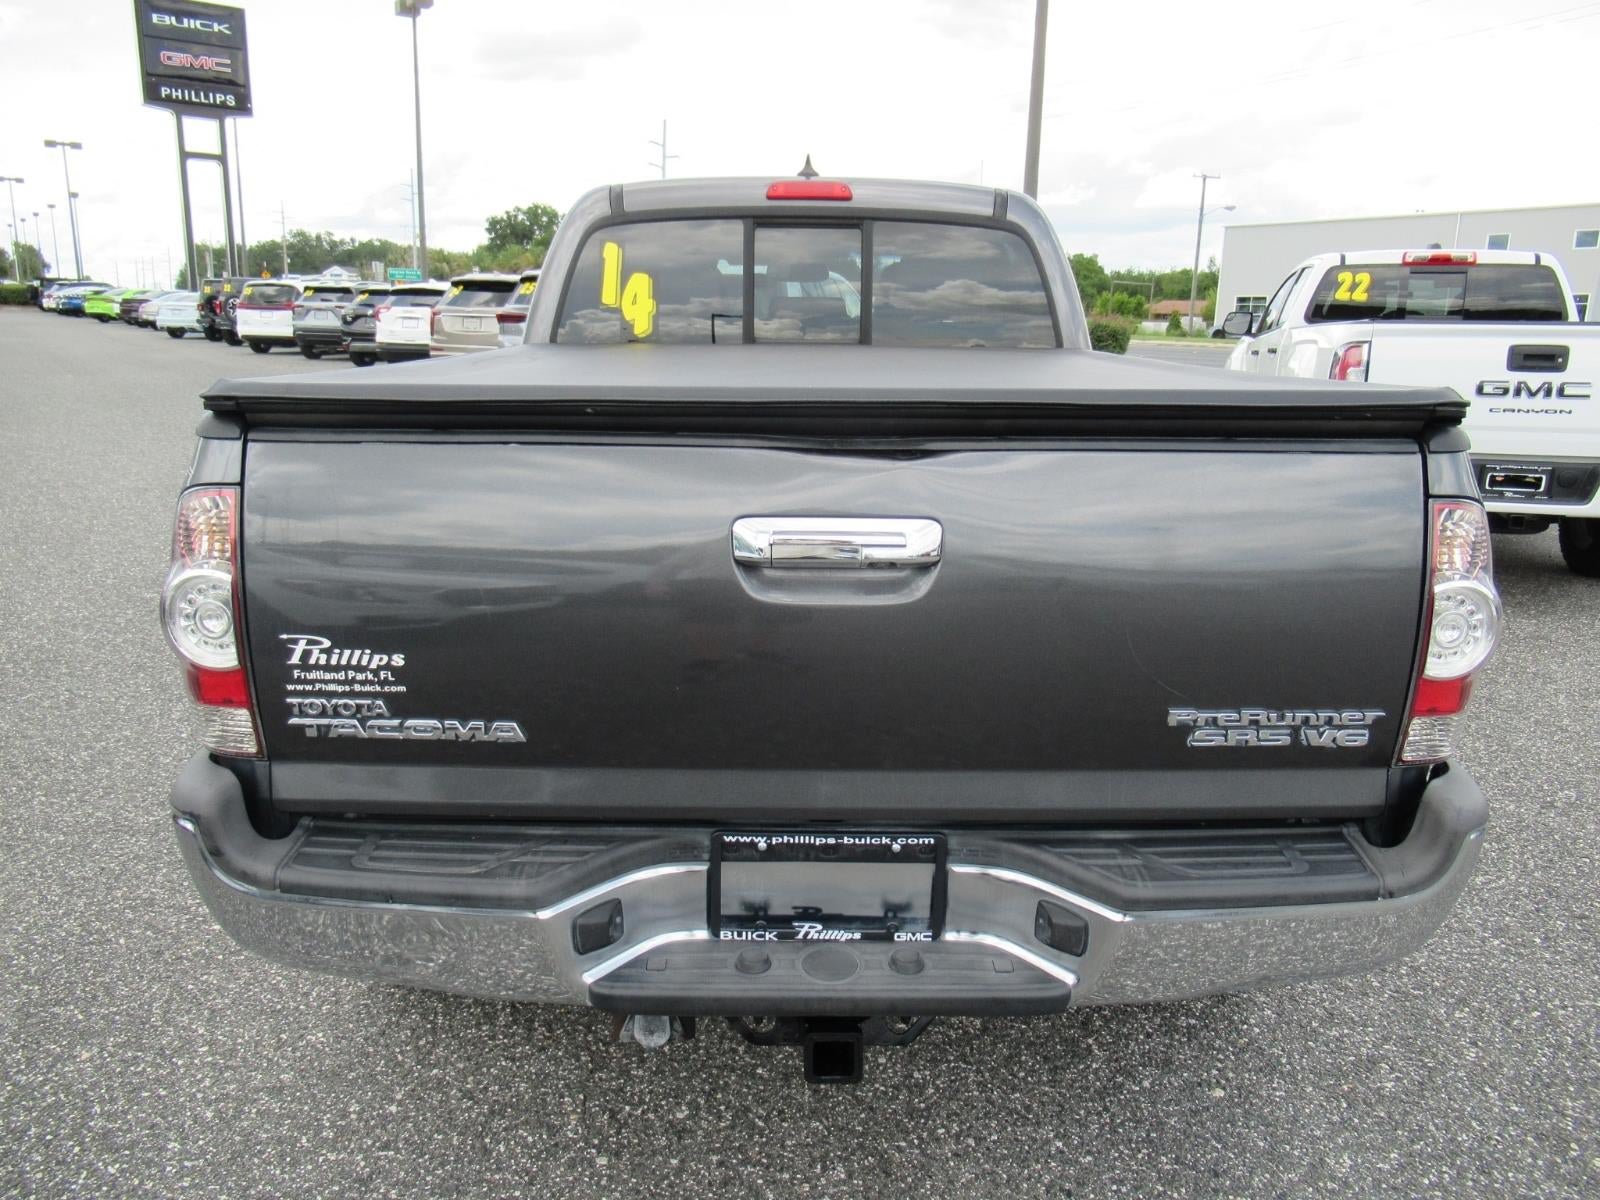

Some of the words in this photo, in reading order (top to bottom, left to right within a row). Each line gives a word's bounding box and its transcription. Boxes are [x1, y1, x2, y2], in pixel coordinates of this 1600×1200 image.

[151, 13, 232, 34] BUICK
[160, 51, 231, 72] GMC
[161, 86, 236, 106] PHILLIPS
[1334, 271, 1370, 302] 22
[1475, 380, 1592, 399] GMC
[1488, 407, 1573, 415] CANYON
[279, 633, 407, 669] Phillips
[293, 669, 346, 681] Fruitland
[348, 670, 378, 682] Park,
[381, 671, 395, 681] FL
[286, 682, 407, 693] www.Phillips-Buick.com
[285, 698, 390, 717] TOYOTA
[1167, 708, 1386, 727] PreRunner
[288, 718, 527, 743] TACOMA
[1187, 728, 1291, 748] SR5
[1301, 727, 1369, 748] V6
[723, 834, 935, 846] www.phillips-buick.com
[719, 930, 779, 941] BUICK
[792, 922, 862, 942] Phillips
[894, 932, 933, 942] GMC
